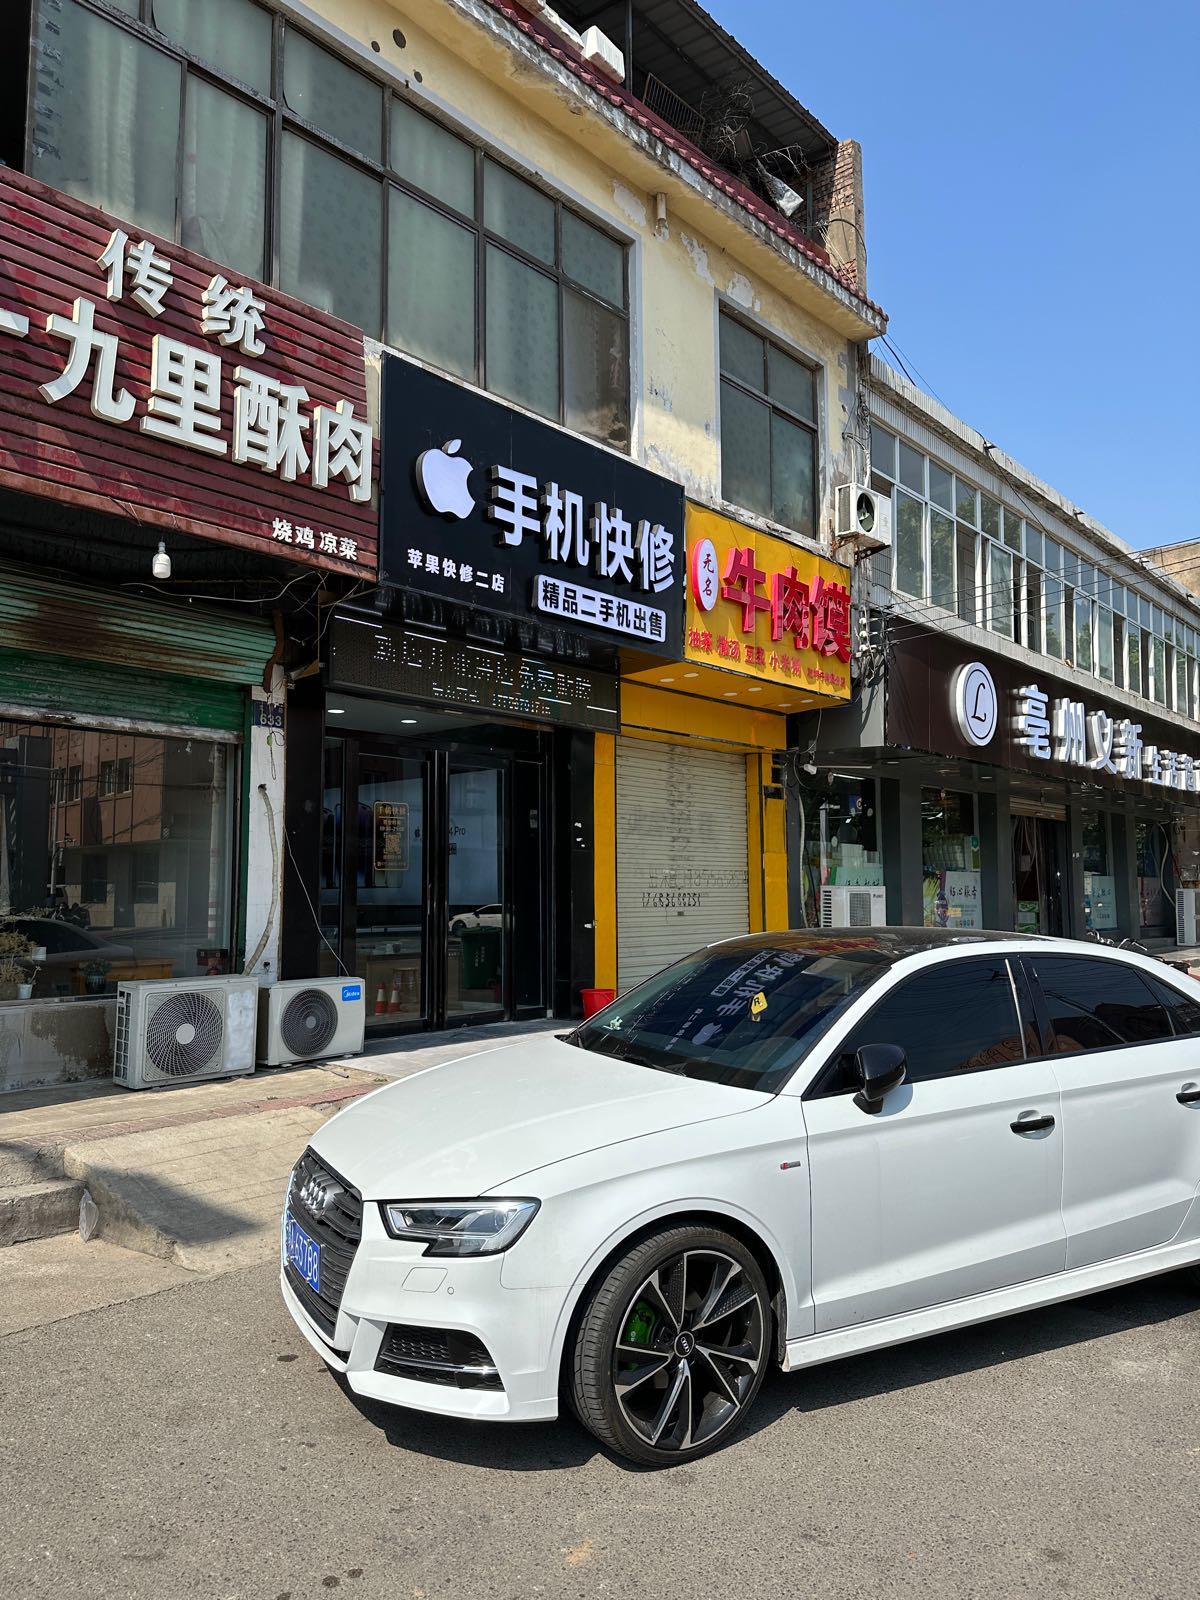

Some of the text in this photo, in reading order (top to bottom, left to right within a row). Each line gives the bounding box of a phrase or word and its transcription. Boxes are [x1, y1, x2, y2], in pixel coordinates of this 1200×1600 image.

[97, 228, 266, 357] 传统
[407, 548, 505, 593] 苹果快修二店
[488, 464, 676, 594] 手机快修
[542, 579, 663, 639] 精品二手机出售
[721, 547, 852, 663] 牛肉馍
[260, 713, 282, 727] 633
